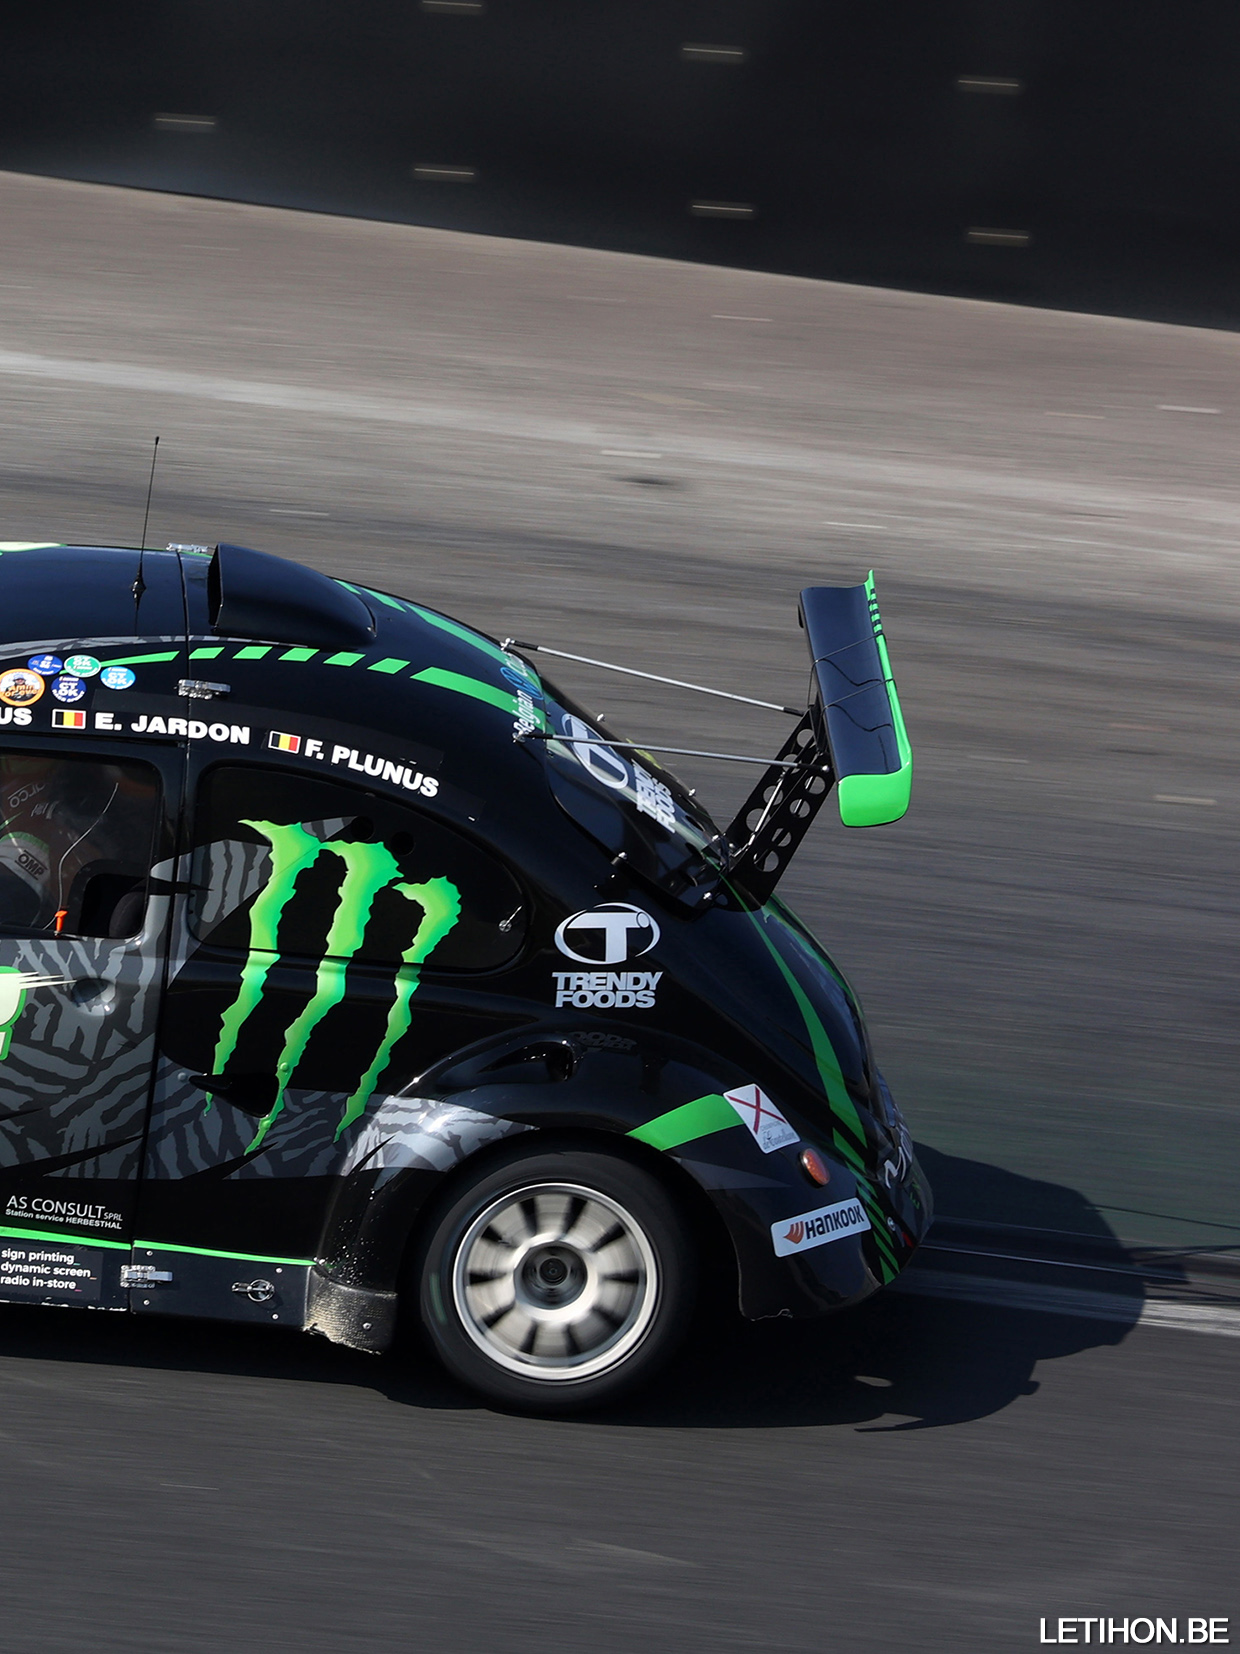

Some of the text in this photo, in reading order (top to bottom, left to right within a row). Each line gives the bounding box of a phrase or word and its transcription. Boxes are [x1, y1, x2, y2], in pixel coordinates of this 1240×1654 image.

[95, 712, 250, 745] E. JARDON
[304, 738, 440, 798] F. PLUNUS
[17, 853, 45, 877] OMP
[552, 971, 663, 990] TRENDY
[555, 990, 656, 1008] FOODS
[6, 1195, 123, 1221] AS CONSULT SPRL
[5, 1208, 122, 1230] Station service HERBESTHAL
[1, 1248, 25, 1260] sign
[0, 1261, 51, 1274] dynamic
[0, 1275, 30, 1286] radio
